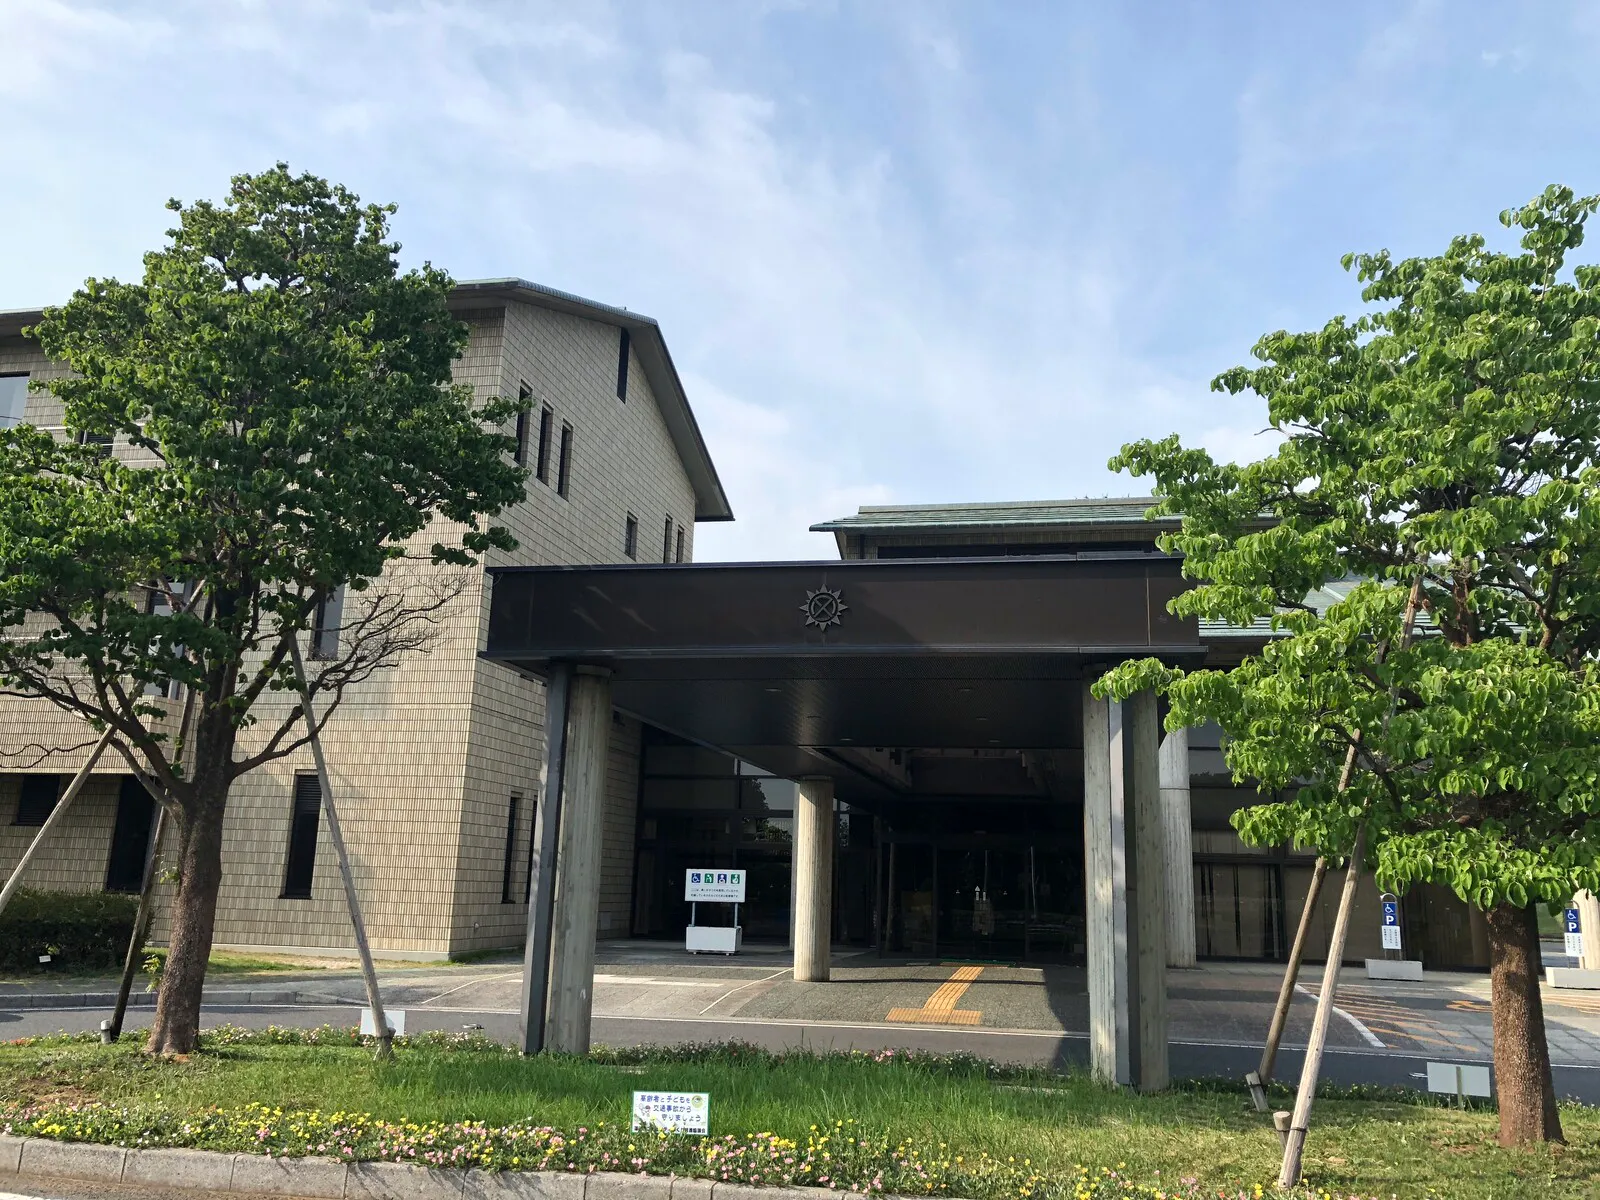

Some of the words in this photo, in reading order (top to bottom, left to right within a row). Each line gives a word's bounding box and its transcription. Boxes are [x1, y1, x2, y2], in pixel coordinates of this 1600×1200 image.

[1386, 915, 1395, 925] P
[1568, 922, 1577, 932] P
[653, 1104, 692, 1113] 交通事故から
[661, 1114, 702, 1122] 守りましょう
